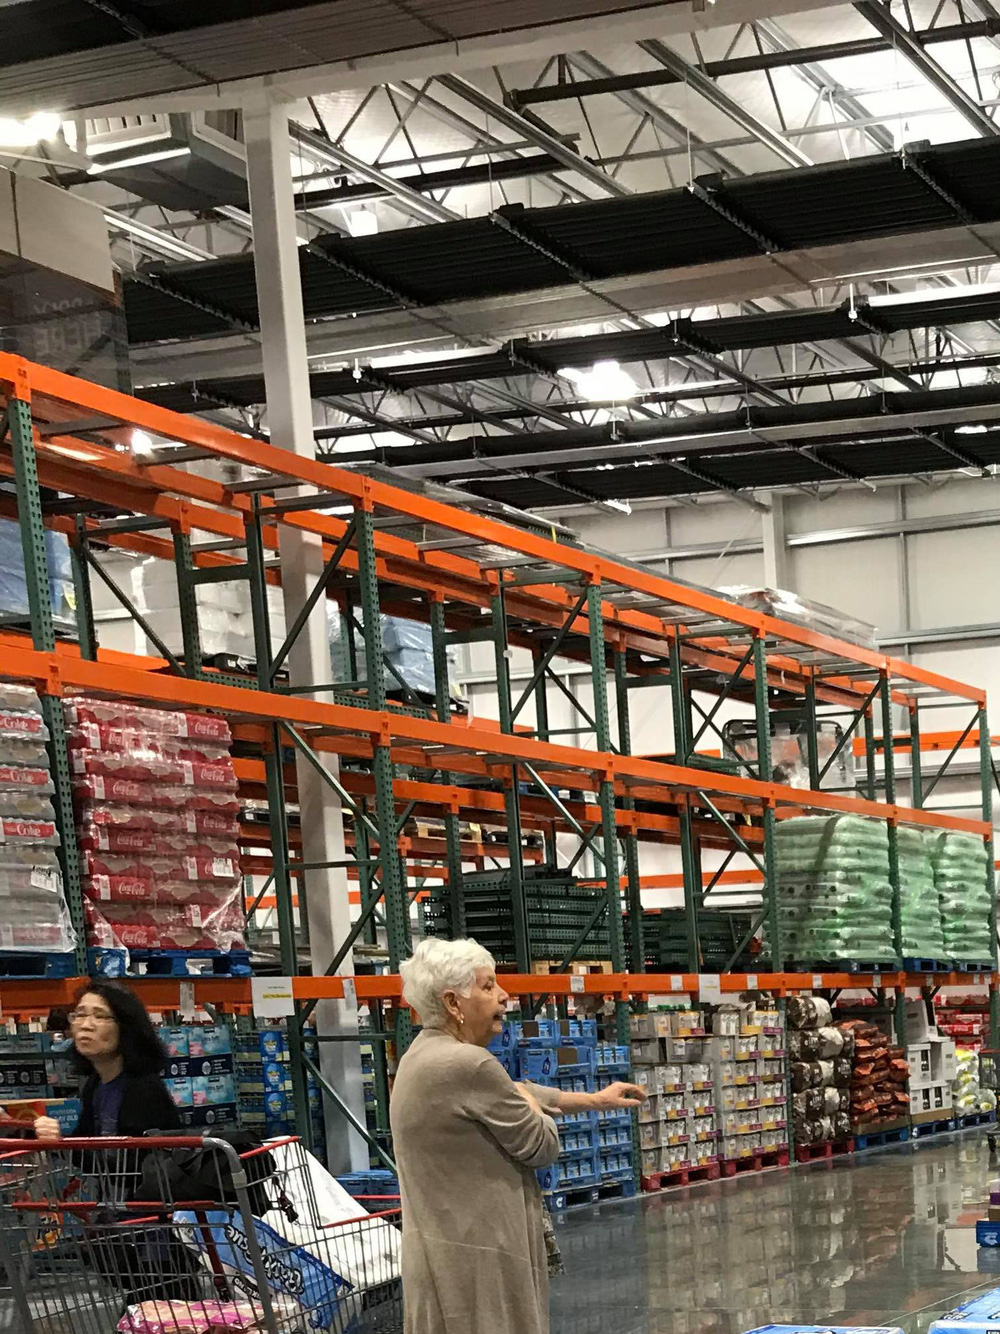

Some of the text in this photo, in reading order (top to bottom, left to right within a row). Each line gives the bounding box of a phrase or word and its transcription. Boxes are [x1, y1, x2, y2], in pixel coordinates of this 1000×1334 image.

[4, 714, 29, 730] Coke
[10, 768, 34, 783] Coke
[17, 823, 41, 837] Coke
